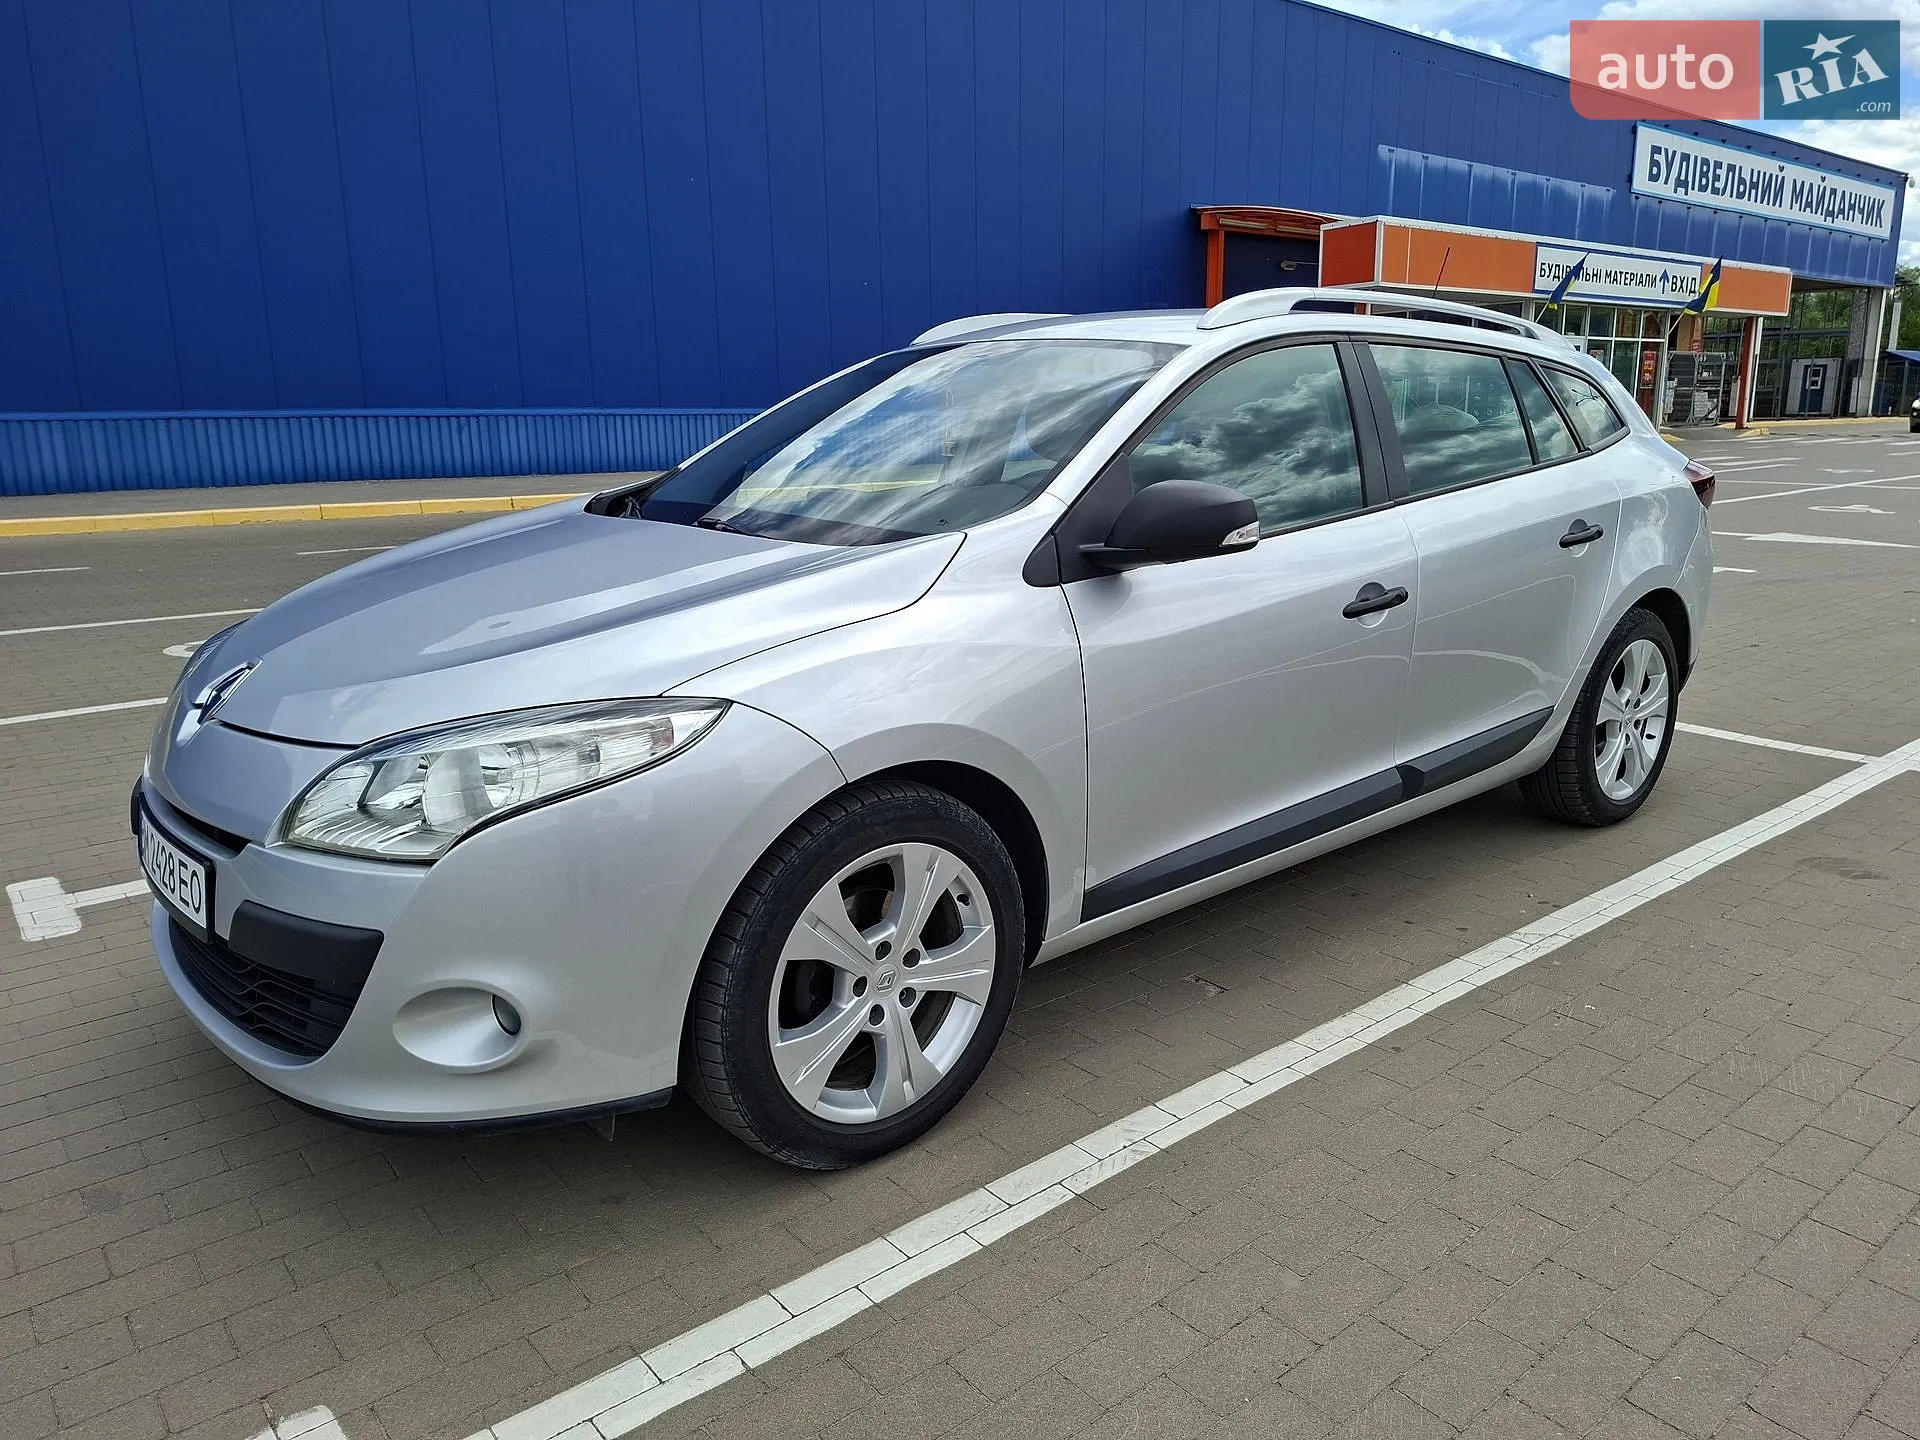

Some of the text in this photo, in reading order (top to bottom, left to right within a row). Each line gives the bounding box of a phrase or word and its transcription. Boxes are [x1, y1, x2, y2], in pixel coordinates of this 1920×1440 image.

[1647, 144, 1887, 229] БУДІВЕЛЬНИЙ МАЙДАНЧИК
[1539, 261, 1697, 297] БУДІВЛЬНІ МАТЕРІАЛИ ВХІД
[150, 830, 176, 895] 2428
[178, 858, 202, 915] EO
